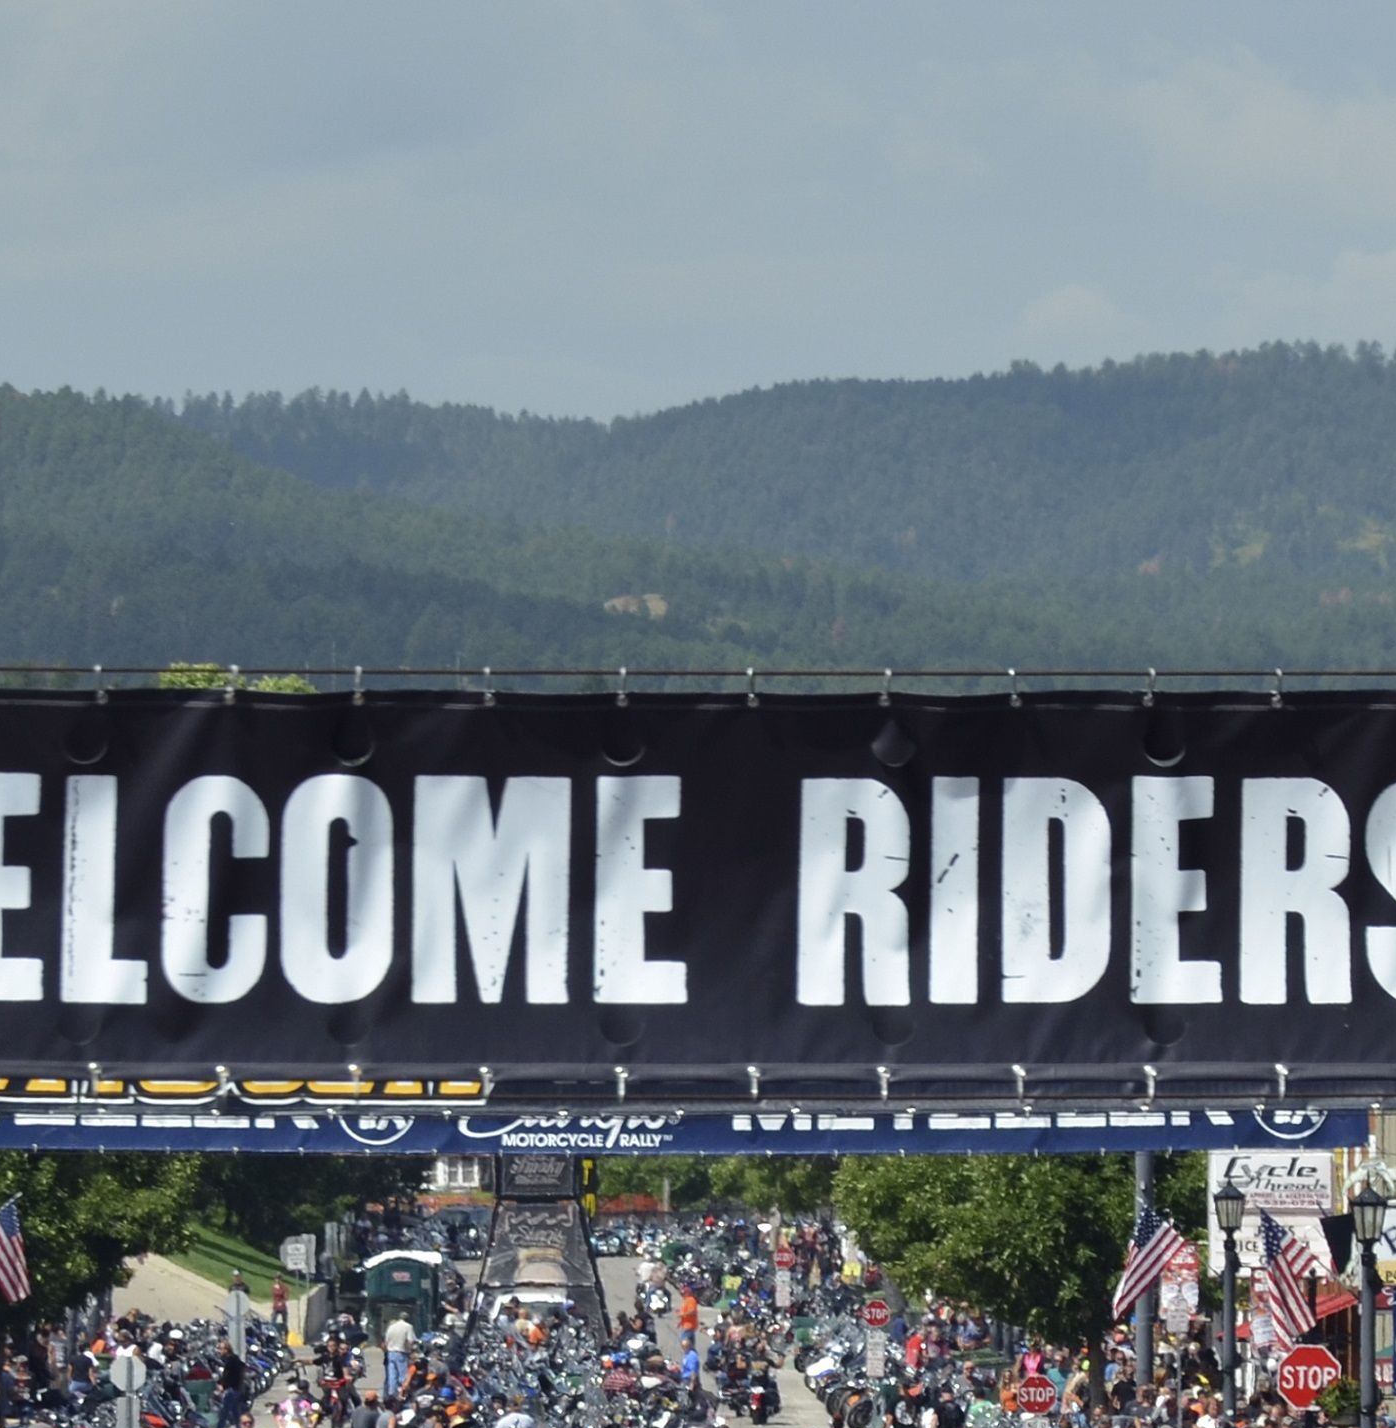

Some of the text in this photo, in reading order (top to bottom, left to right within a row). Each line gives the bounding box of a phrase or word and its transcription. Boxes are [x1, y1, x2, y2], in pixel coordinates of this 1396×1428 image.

[502, 1133, 662, 1147] MOTORCYCLE RALLY
[865, 1309, 889, 1320] STOP
[1281, 1365, 1338, 1391] STOP
[1019, 1387, 1055, 1403] STOP
